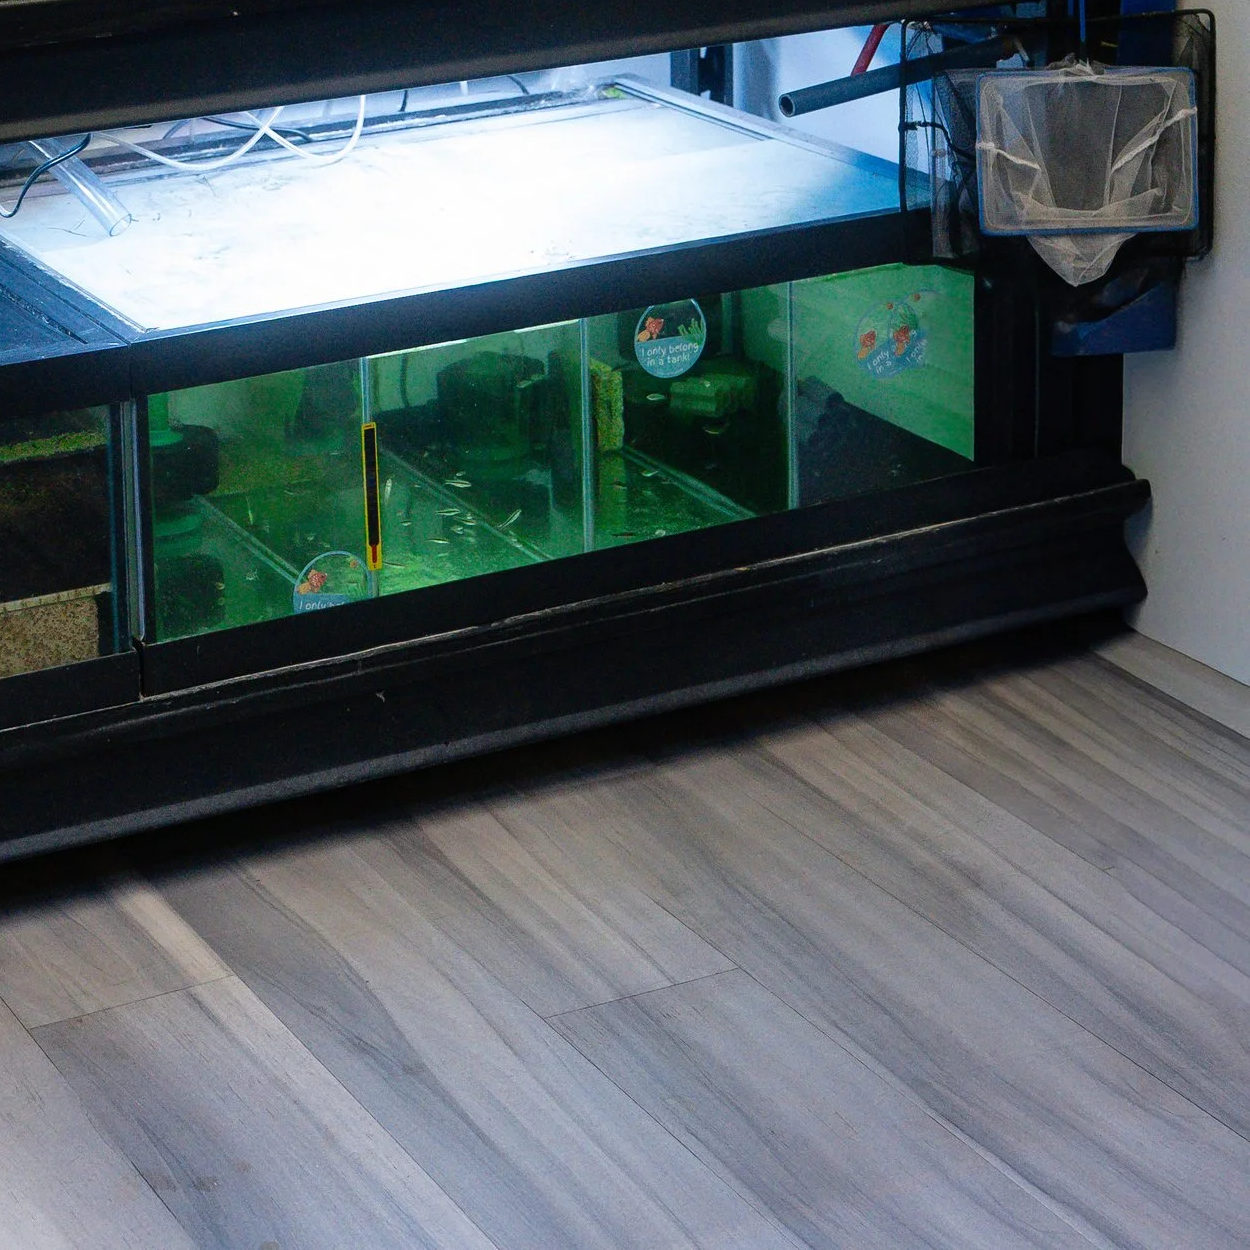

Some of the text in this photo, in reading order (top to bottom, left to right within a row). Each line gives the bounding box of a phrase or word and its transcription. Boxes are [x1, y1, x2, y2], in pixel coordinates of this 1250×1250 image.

[647, 346, 666, 357] only
[669, 342, 699, 354] belong
[647, 353, 690, 366] in a tank!
[872, 350, 890, 366] only
[875, 365, 885, 374] in
